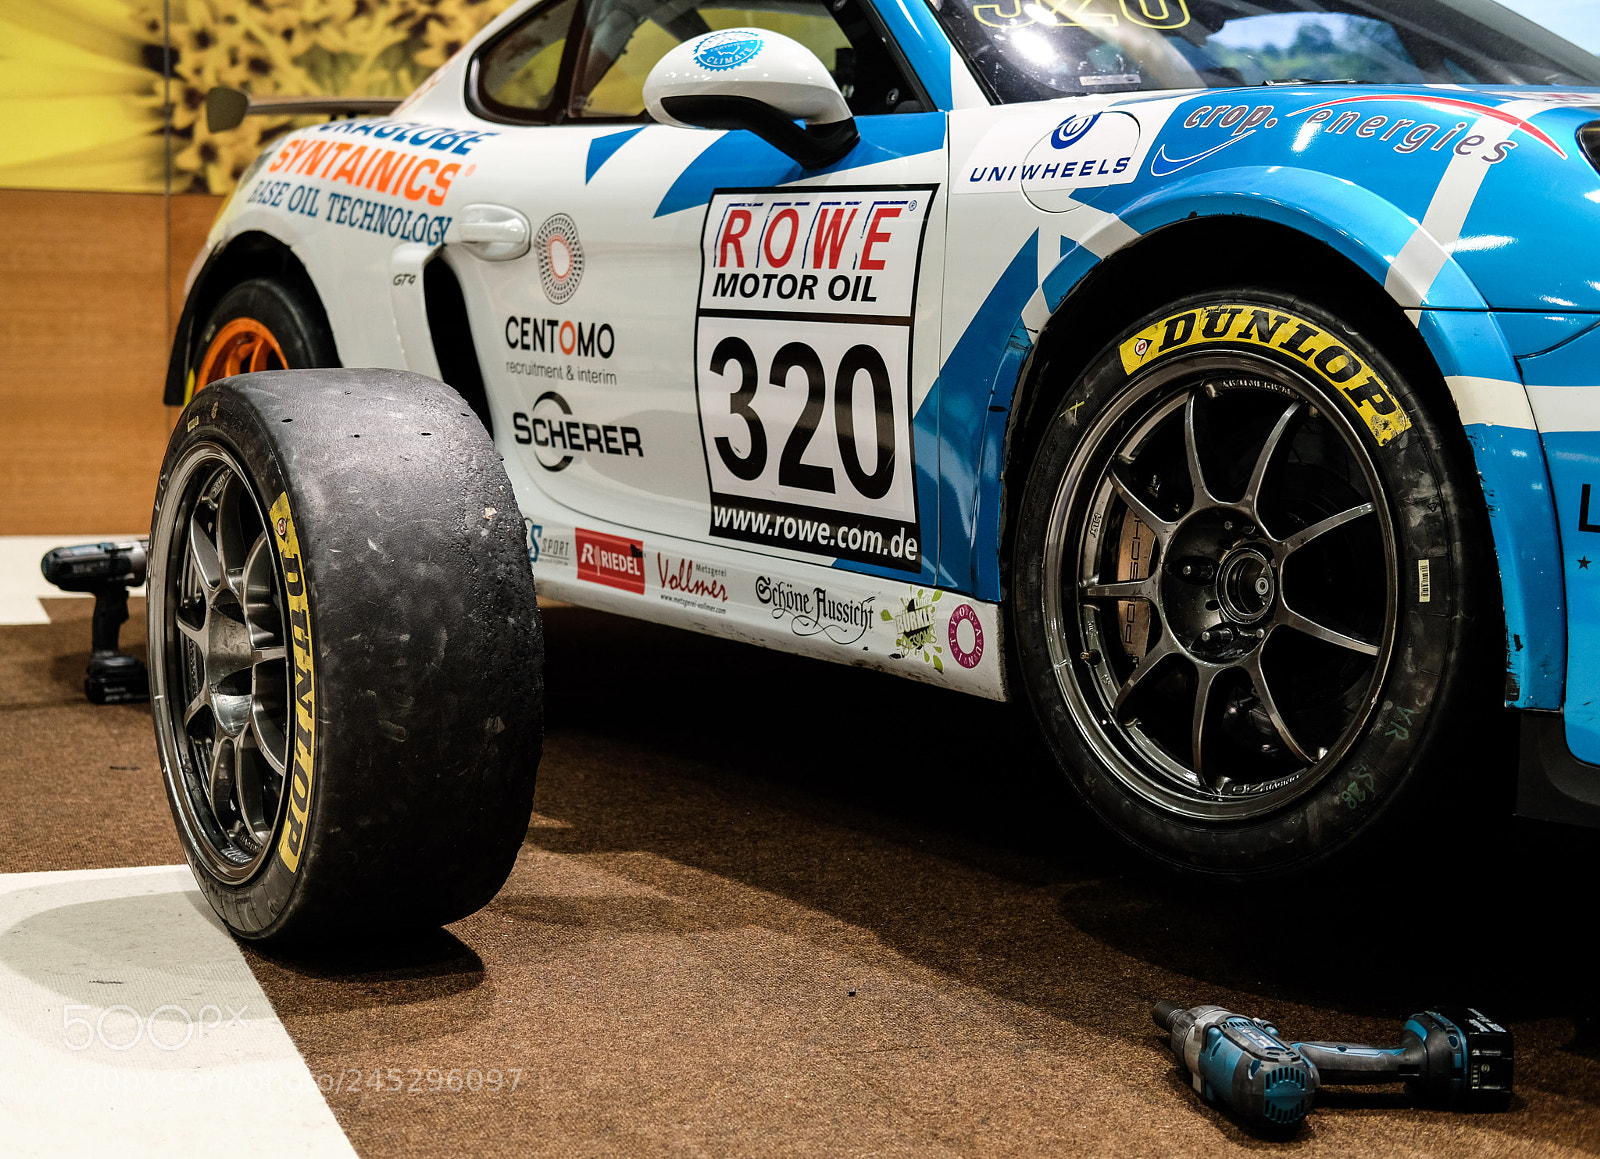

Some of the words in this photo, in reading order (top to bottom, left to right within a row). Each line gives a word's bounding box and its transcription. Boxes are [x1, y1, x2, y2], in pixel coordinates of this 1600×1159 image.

[706, 47, 753, 65] CLIMATE
[1184, 104, 1278, 136] crop.
[1307, 108, 1518, 163] energies
[268, 139, 462, 207] SYNTAINICS
[969, 156, 1131, 182] UNIWHEELS
[288, 185, 321, 217] OIL
[325, 192, 453, 247] TECHNOLOGY
[714, 201, 908, 271] ROWE
[712, 273, 818, 299] MOTOR
[827, 275, 877, 302] OIL
[505, 315, 615, 359] CENTOMO
[506, 361, 563, 380] recruitment
[566, 365, 574, 380] &
[577, 366, 617, 385] interim
[1158, 307, 1398, 416] DUNLOP
[513, 411, 644, 457] SCHERER
[709, 336, 896, 500] 320
[541, 538, 569, 557] SPORT
[713, 505, 918, 561] www.rowe.com.de
[601, 549, 641, 576] RIEDEL
[657, 552, 728, 602] Vollmer
[696, 563, 727, 577] Metzgerei
[660, 594, 726, 614] www.metzgerei-vollmer.com
[755, 575, 814, 619] Schöne
[810, 587, 876, 632] Aussicht
[282, 552, 313, 857] DUNLOP
